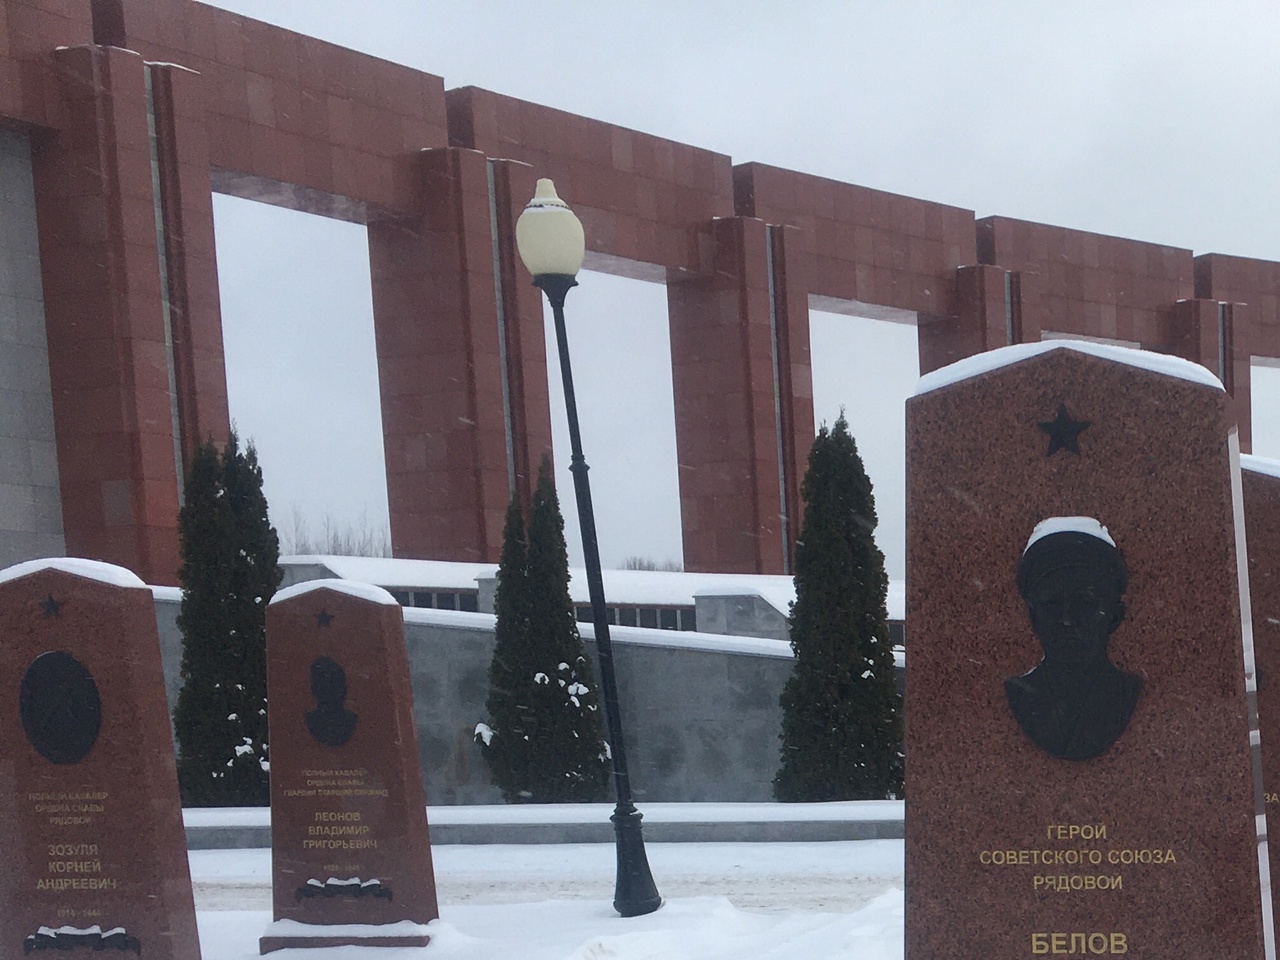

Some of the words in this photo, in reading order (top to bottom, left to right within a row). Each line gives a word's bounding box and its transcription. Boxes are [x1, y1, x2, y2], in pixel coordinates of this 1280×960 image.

[314, 811, 361, 821] ЛЕОНОВ
[308, 826, 370, 836] ВЛАДИМИР
[48, 844, 98, 856] ЗОЗУЛЯ
[303, 839, 377, 849] ГРИГОРЬЕВИЧ
[980, 850, 1102, 865] СОВЕТСКОГО
[1107, 849, 1176, 864] СОЮЗА
[48, 859, 101, 872] КОРНЕЙ
[37, 878, 117, 890] АНДРЕЕВИЧ
[1033, 873, 1123, 892] РЯДОВОЙ
[1031, 933, 1128, 954] БЕЛОВ
